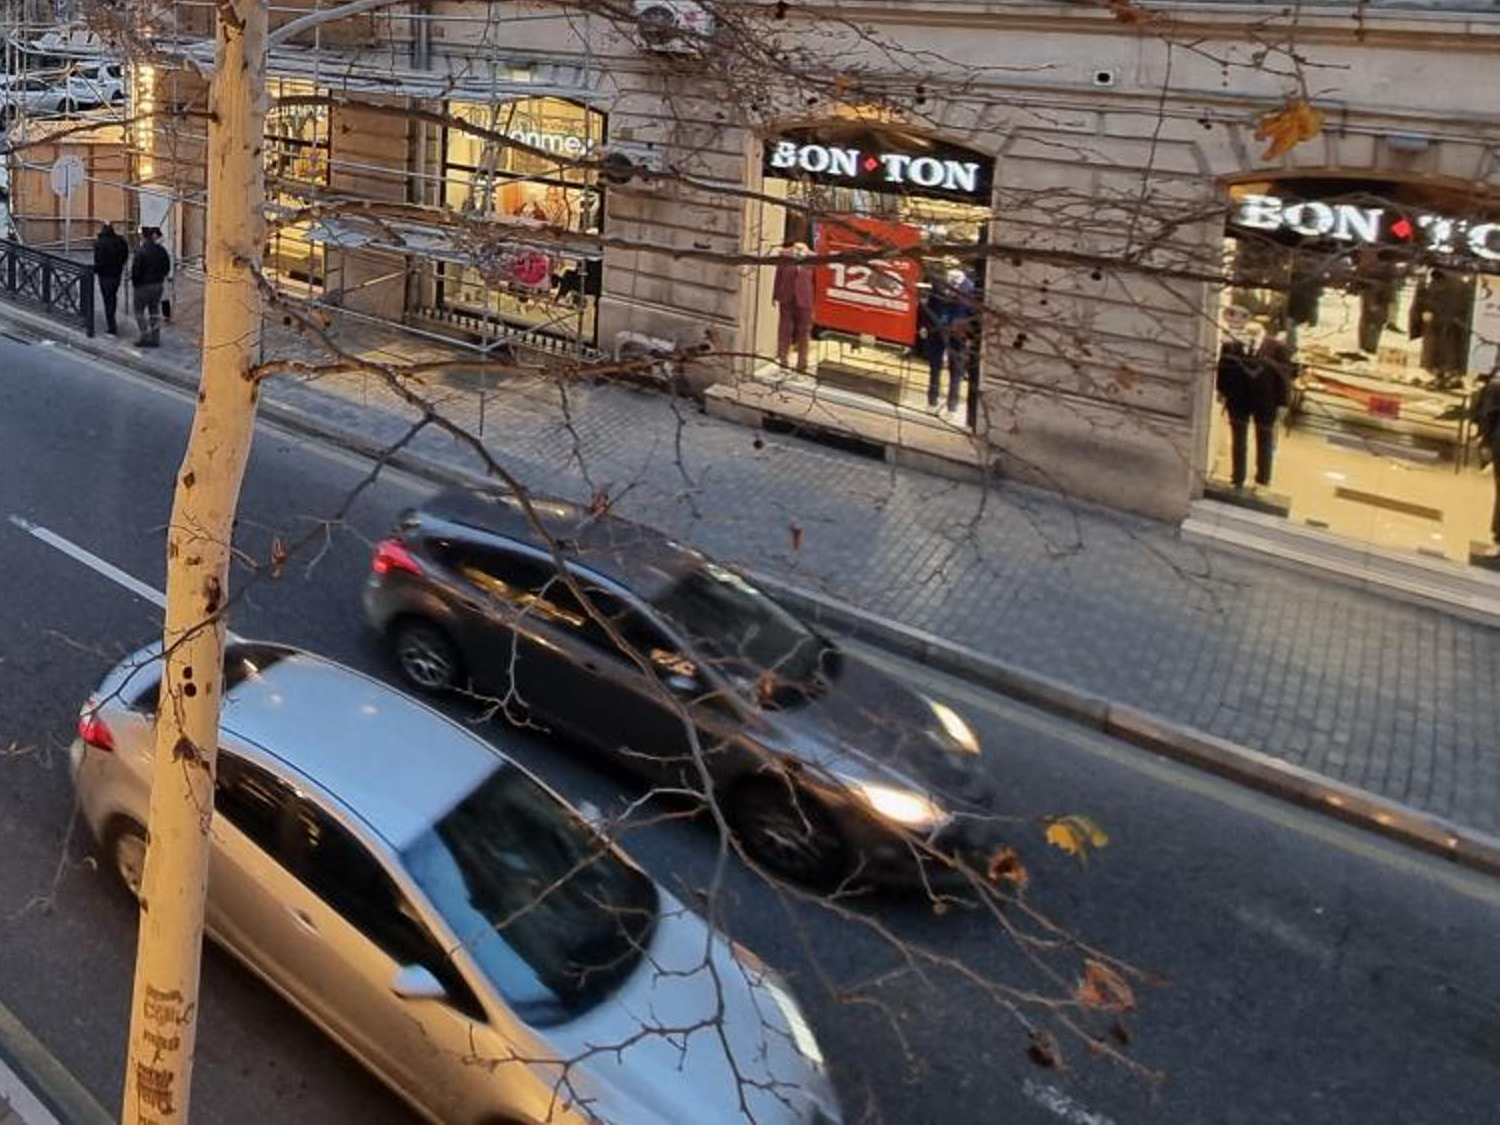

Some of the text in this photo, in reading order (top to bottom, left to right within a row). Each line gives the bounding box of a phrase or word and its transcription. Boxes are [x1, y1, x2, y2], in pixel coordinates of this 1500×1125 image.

[771, 141, 981, 193] BON TON
[1233, 193, 1384, 243] BON
